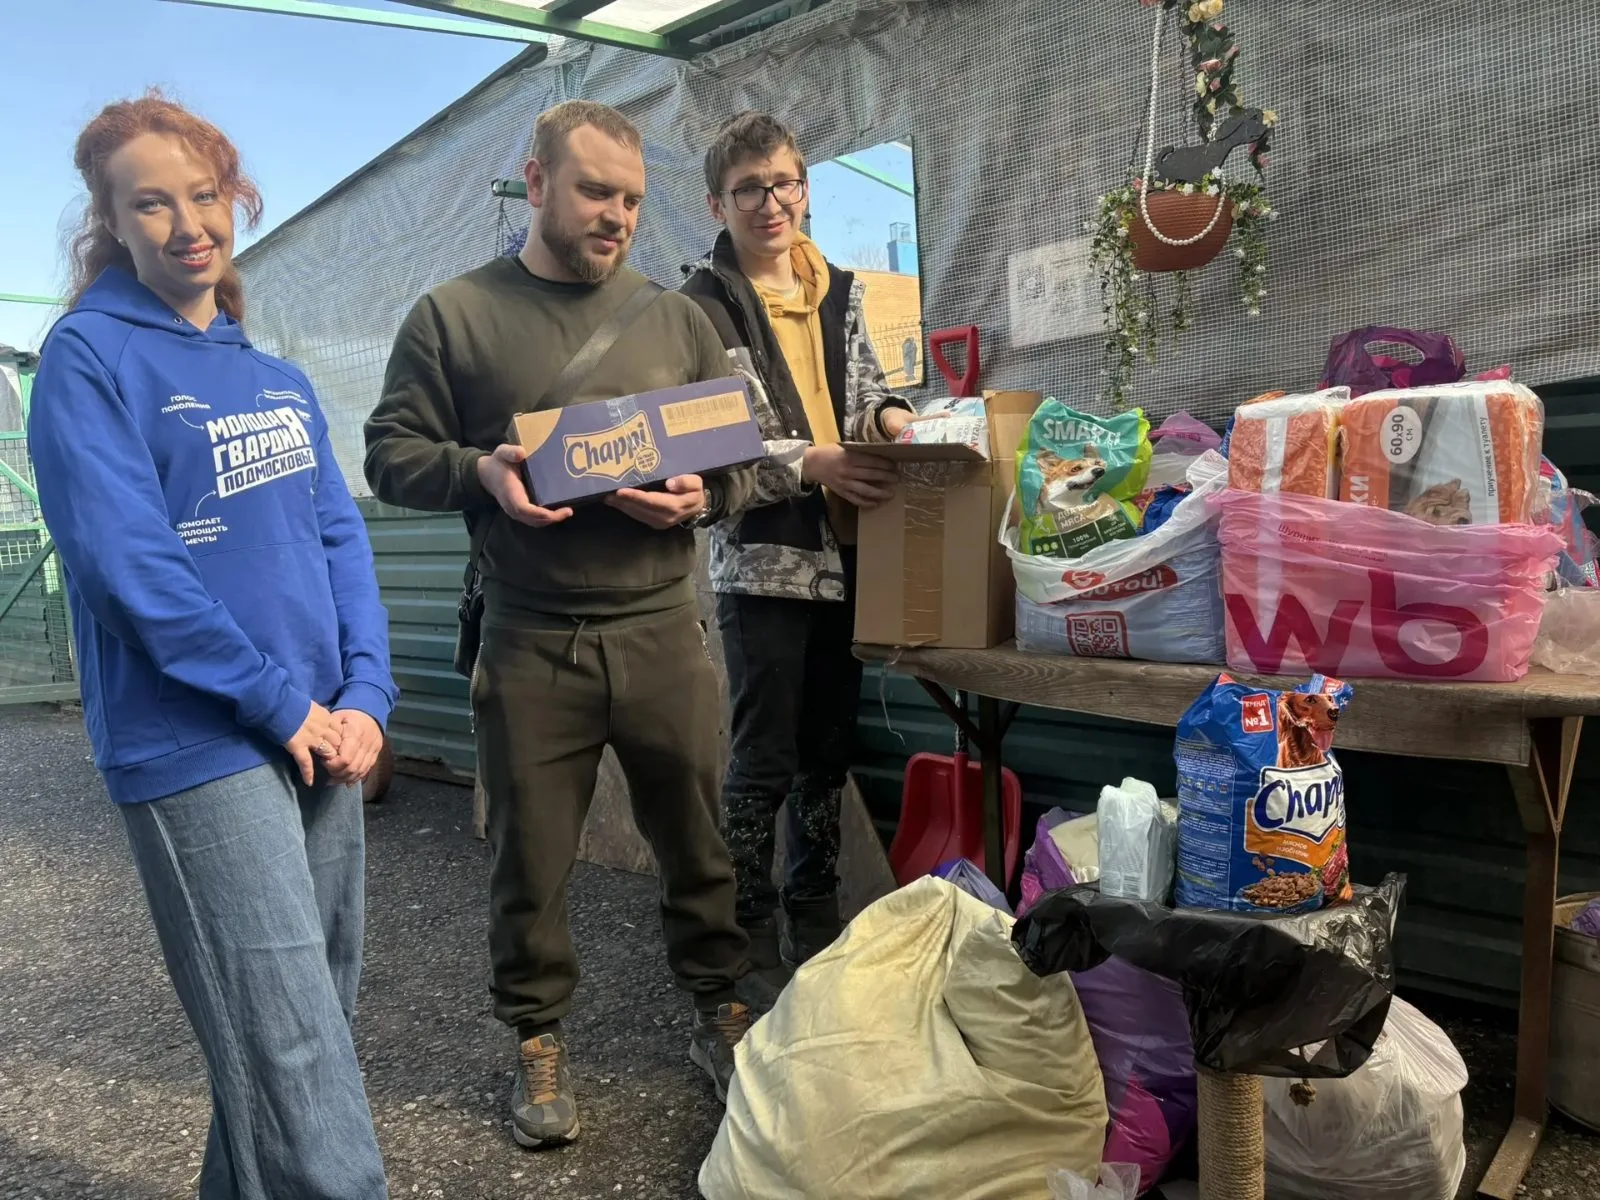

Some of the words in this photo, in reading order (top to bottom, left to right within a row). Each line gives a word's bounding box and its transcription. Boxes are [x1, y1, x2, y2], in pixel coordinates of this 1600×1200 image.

[206, 406, 307, 444] МОЛОДАЯ
[1479, 417, 1490, 447] туалету
[213, 422, 310, 473] ГВАРДИЯ
[566, 422, 647, 472] Chappi
[224, 449, 313, 492] ПОДМОСКОВЬЕ
[1485, 455, 1496, 497] приучение
[176, 517, 221, 530] ПОМОГАЕТ
[178, 525, 228, 538] ОПЛОЩАТЬ
[185, 536, 217, 546] МЕЧТЫ
[1245, 708, 1270, 727] №1
